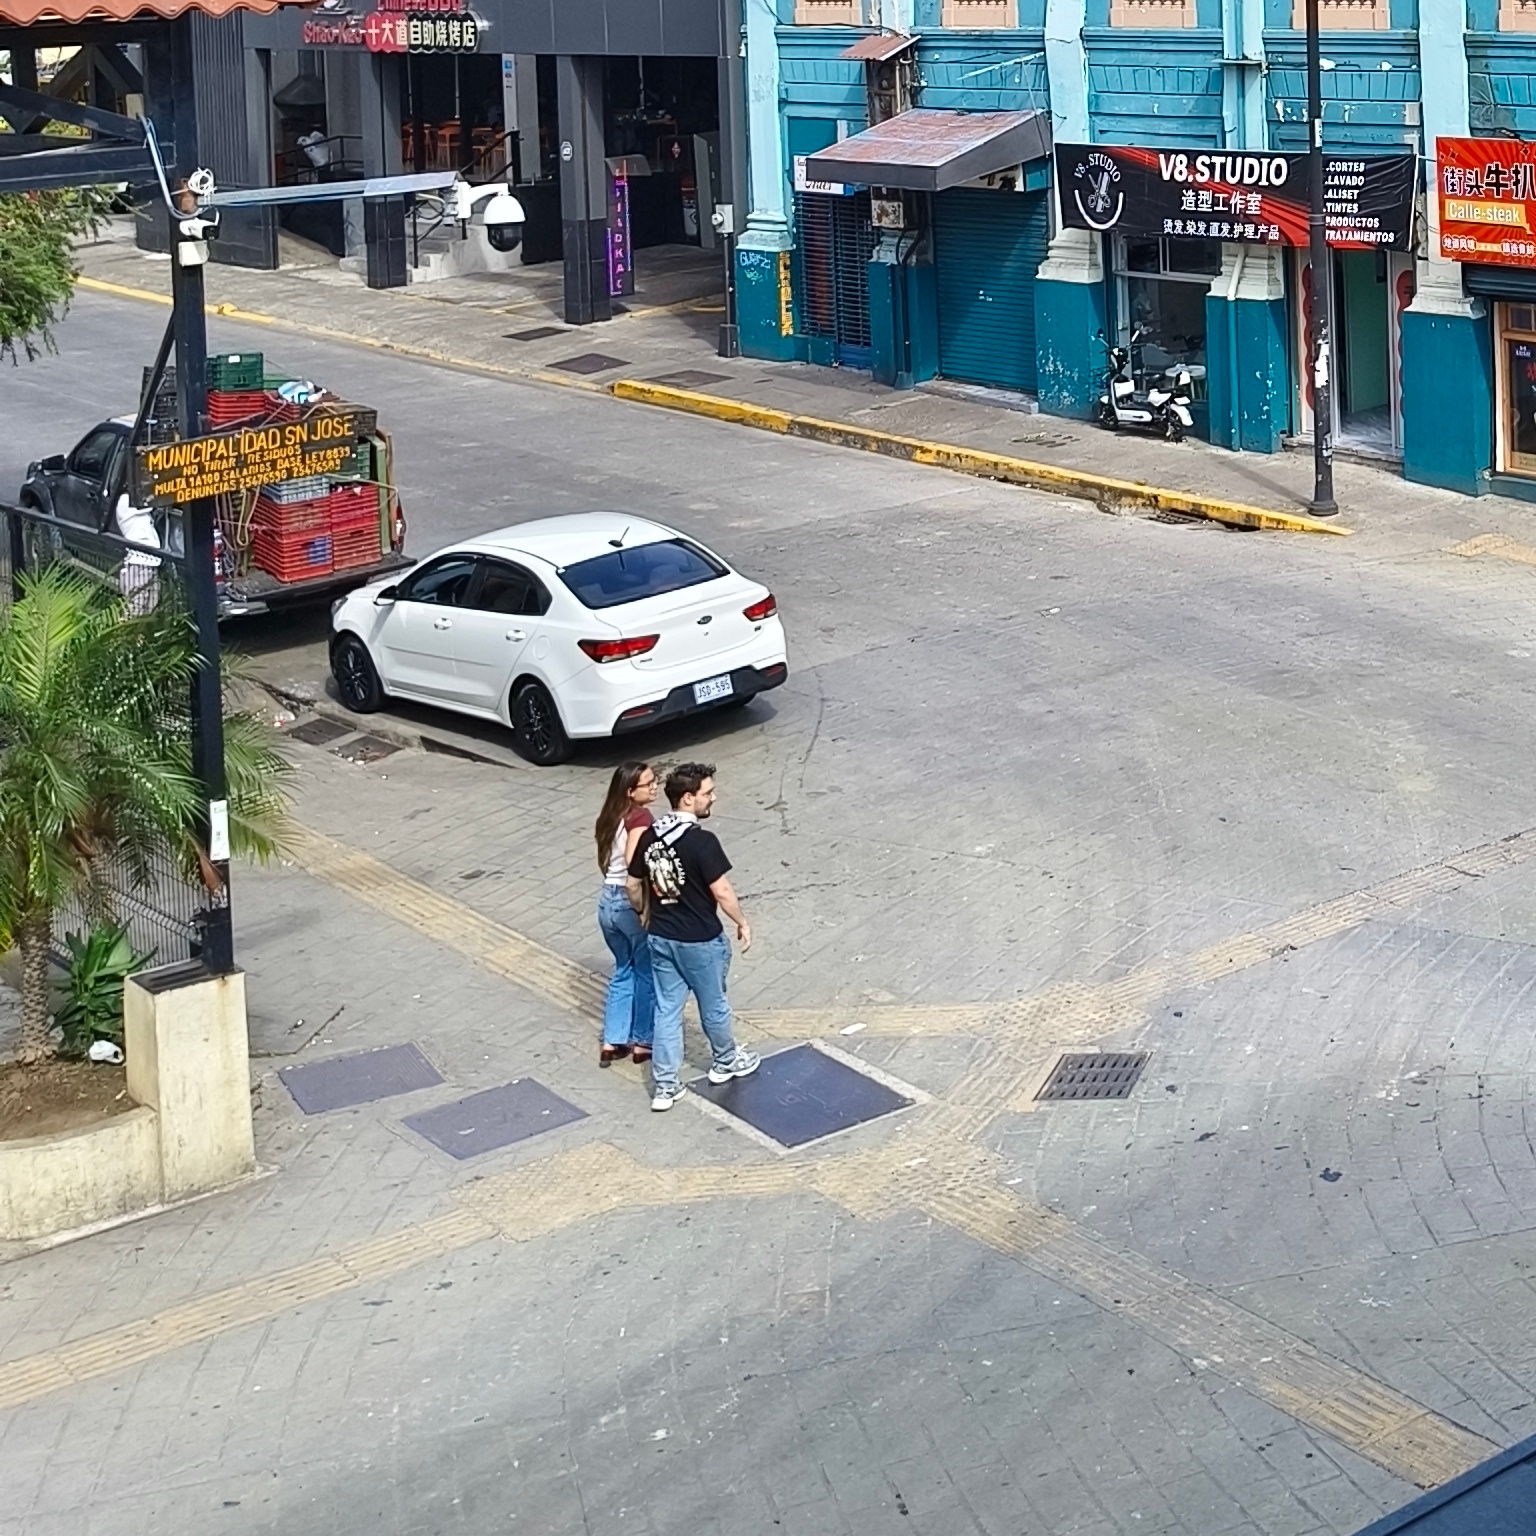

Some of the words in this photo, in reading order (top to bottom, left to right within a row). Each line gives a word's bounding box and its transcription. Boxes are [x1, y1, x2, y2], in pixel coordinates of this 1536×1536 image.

[1159, 153, 1288, 186] V8.STUDIO
[1181, 189, 1262, 215] 造型工作室
[1449, 202, 1521, 223] Calle-steak
[148, 427, 281, 472] MUNICIPALIDAD
[311, 416, 355, 441] JOSE
[155, 479, 187, 496] MULTA
[276, 456, 302, 470] BASE
[183, 465, 198, 476] NO
[248, 445, 301, 464] RESIDUOS
[176, 480, 237, 503] DENUNCIAS
